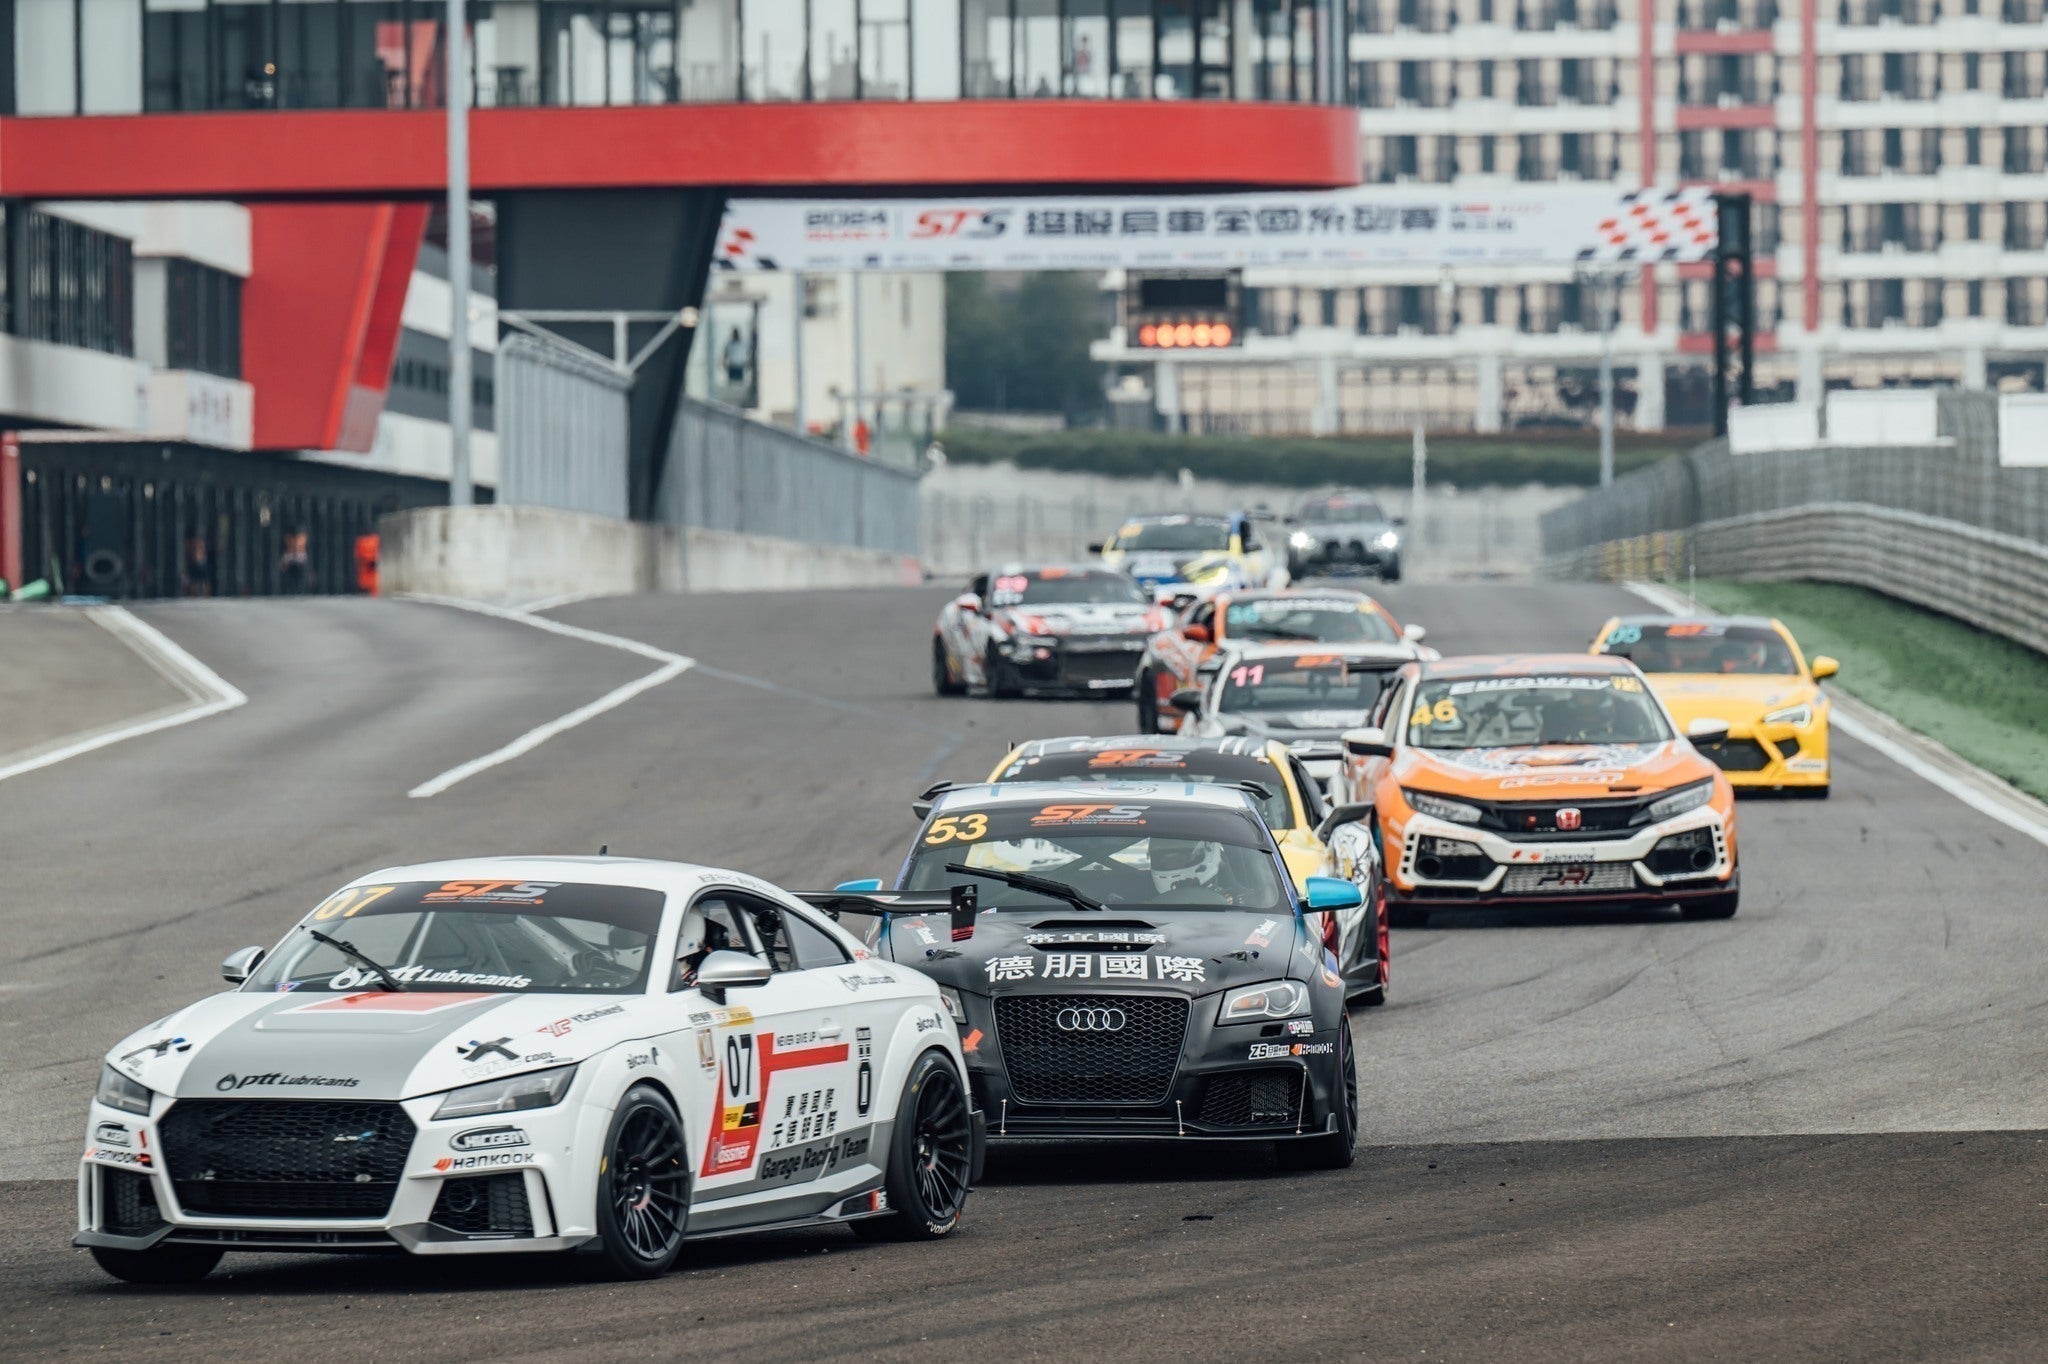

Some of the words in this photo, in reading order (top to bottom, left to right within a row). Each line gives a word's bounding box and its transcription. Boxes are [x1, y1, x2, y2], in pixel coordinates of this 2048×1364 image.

[807, 209, 887, 226] 2024
[911, 208, 1013, 239] STS
[1231, 665, 1264, 687] 11
[1410, 699, 1457, 726] 46
[1088, 749, 1197, 765] STS
[1030, 804, 1150, 821] STS
[925, 814, 988, 844] 53
[424, 879, 563, 898] STS
[313, 886, 396, 920] 07
[415, 968, 533, 989] Lubricants
[984, 953, 1206, 984] 德朋國際
[627, 1053, 651, 1069] alcon
[1251, 1044, 1267, 1058] ZS
[727, 1033, 752, 1098] 07
[236, 1073, 282, 1089] ptt
[278, 1074, 360, 1088] Lubricants
[761, 1154, 801, 1180] Garage
[802, 1142, 840, 1169] Racing
[841, 1137, 870, 1159] Team
